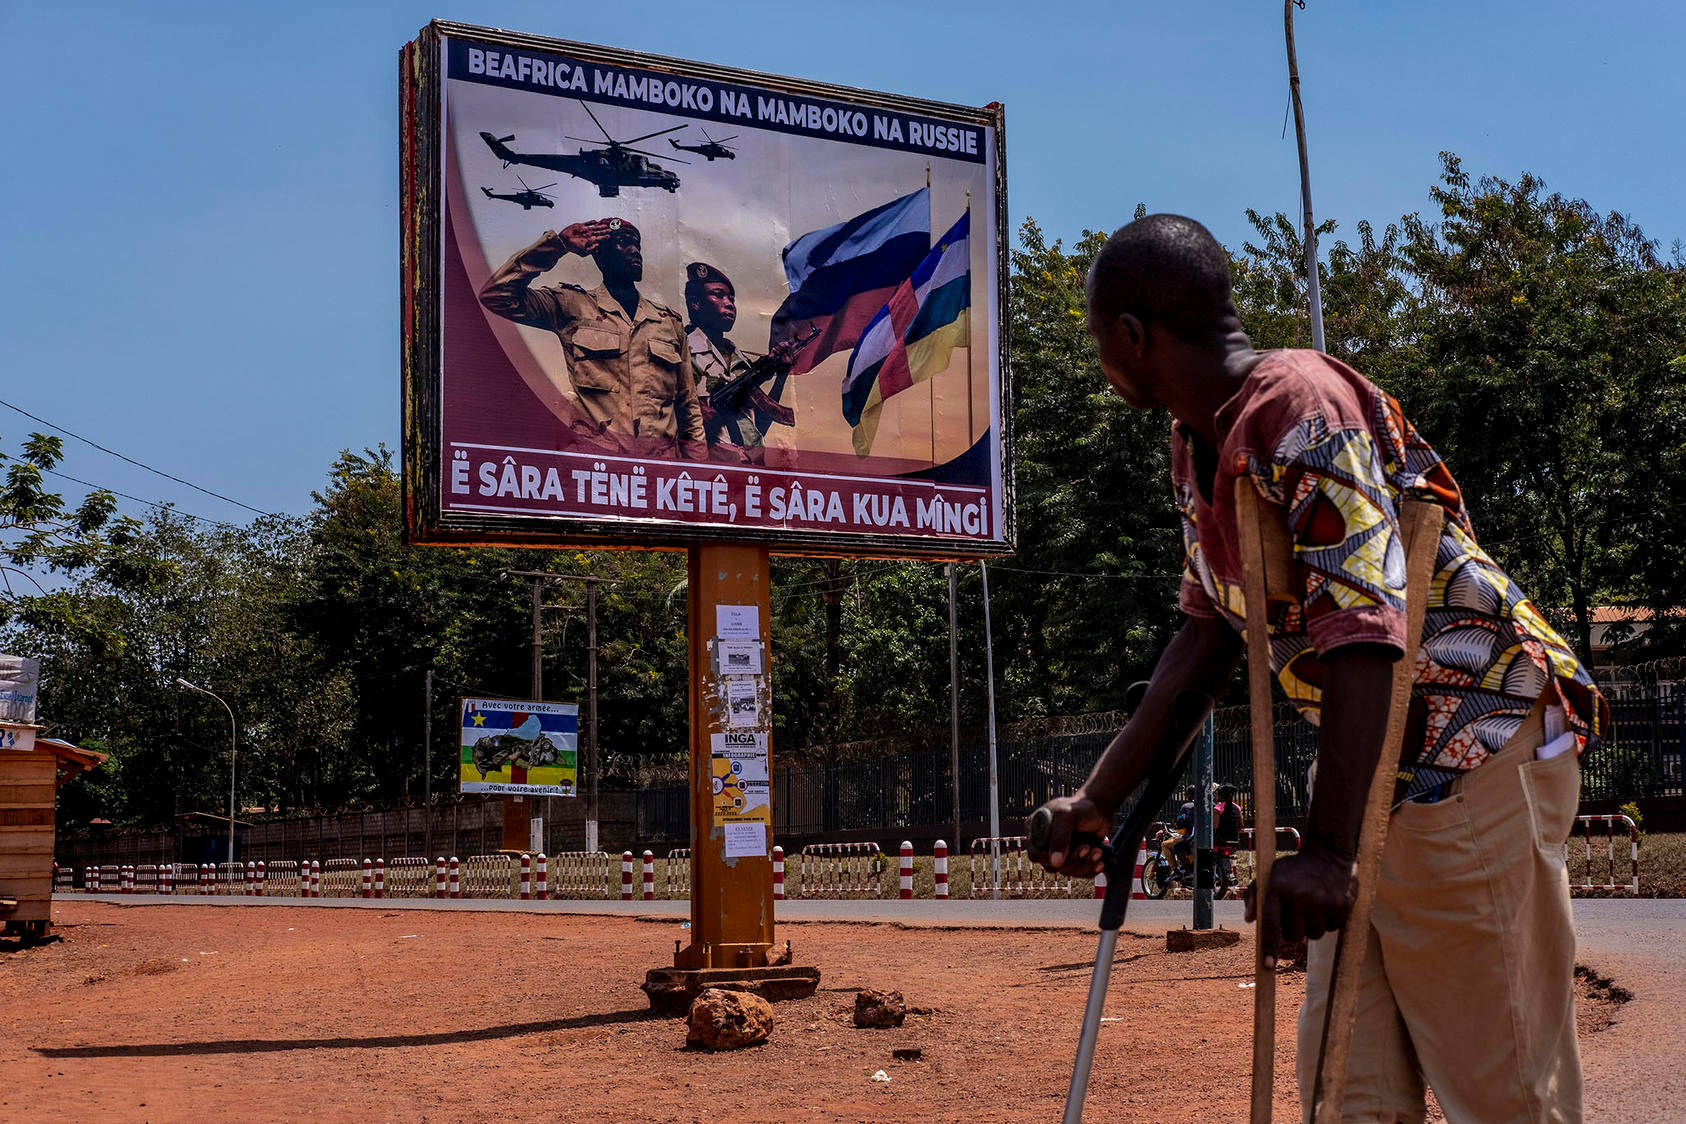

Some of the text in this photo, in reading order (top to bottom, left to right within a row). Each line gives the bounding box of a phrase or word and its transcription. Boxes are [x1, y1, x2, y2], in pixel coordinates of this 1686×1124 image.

[468, 48, 978, 155] BEAFRICA MAMBOKO NA MAMBOKO NA RUSSIE
[451, 450, 470, 494] Ë
[478, 455, 565, 501] SÂRA
[572, 462, 648, 508] TËNË
[656, 471, 737, 522] KÊTÊ,
[745, 475, 762, 518] Ë
[769, 481, 846, 523] SÂRA
[853, 493, 910, 528] KUA
[482, 701, 501, 709] Avec
[504, 703, 525, 711] votre
[725, 734, 756, 743] INGA
